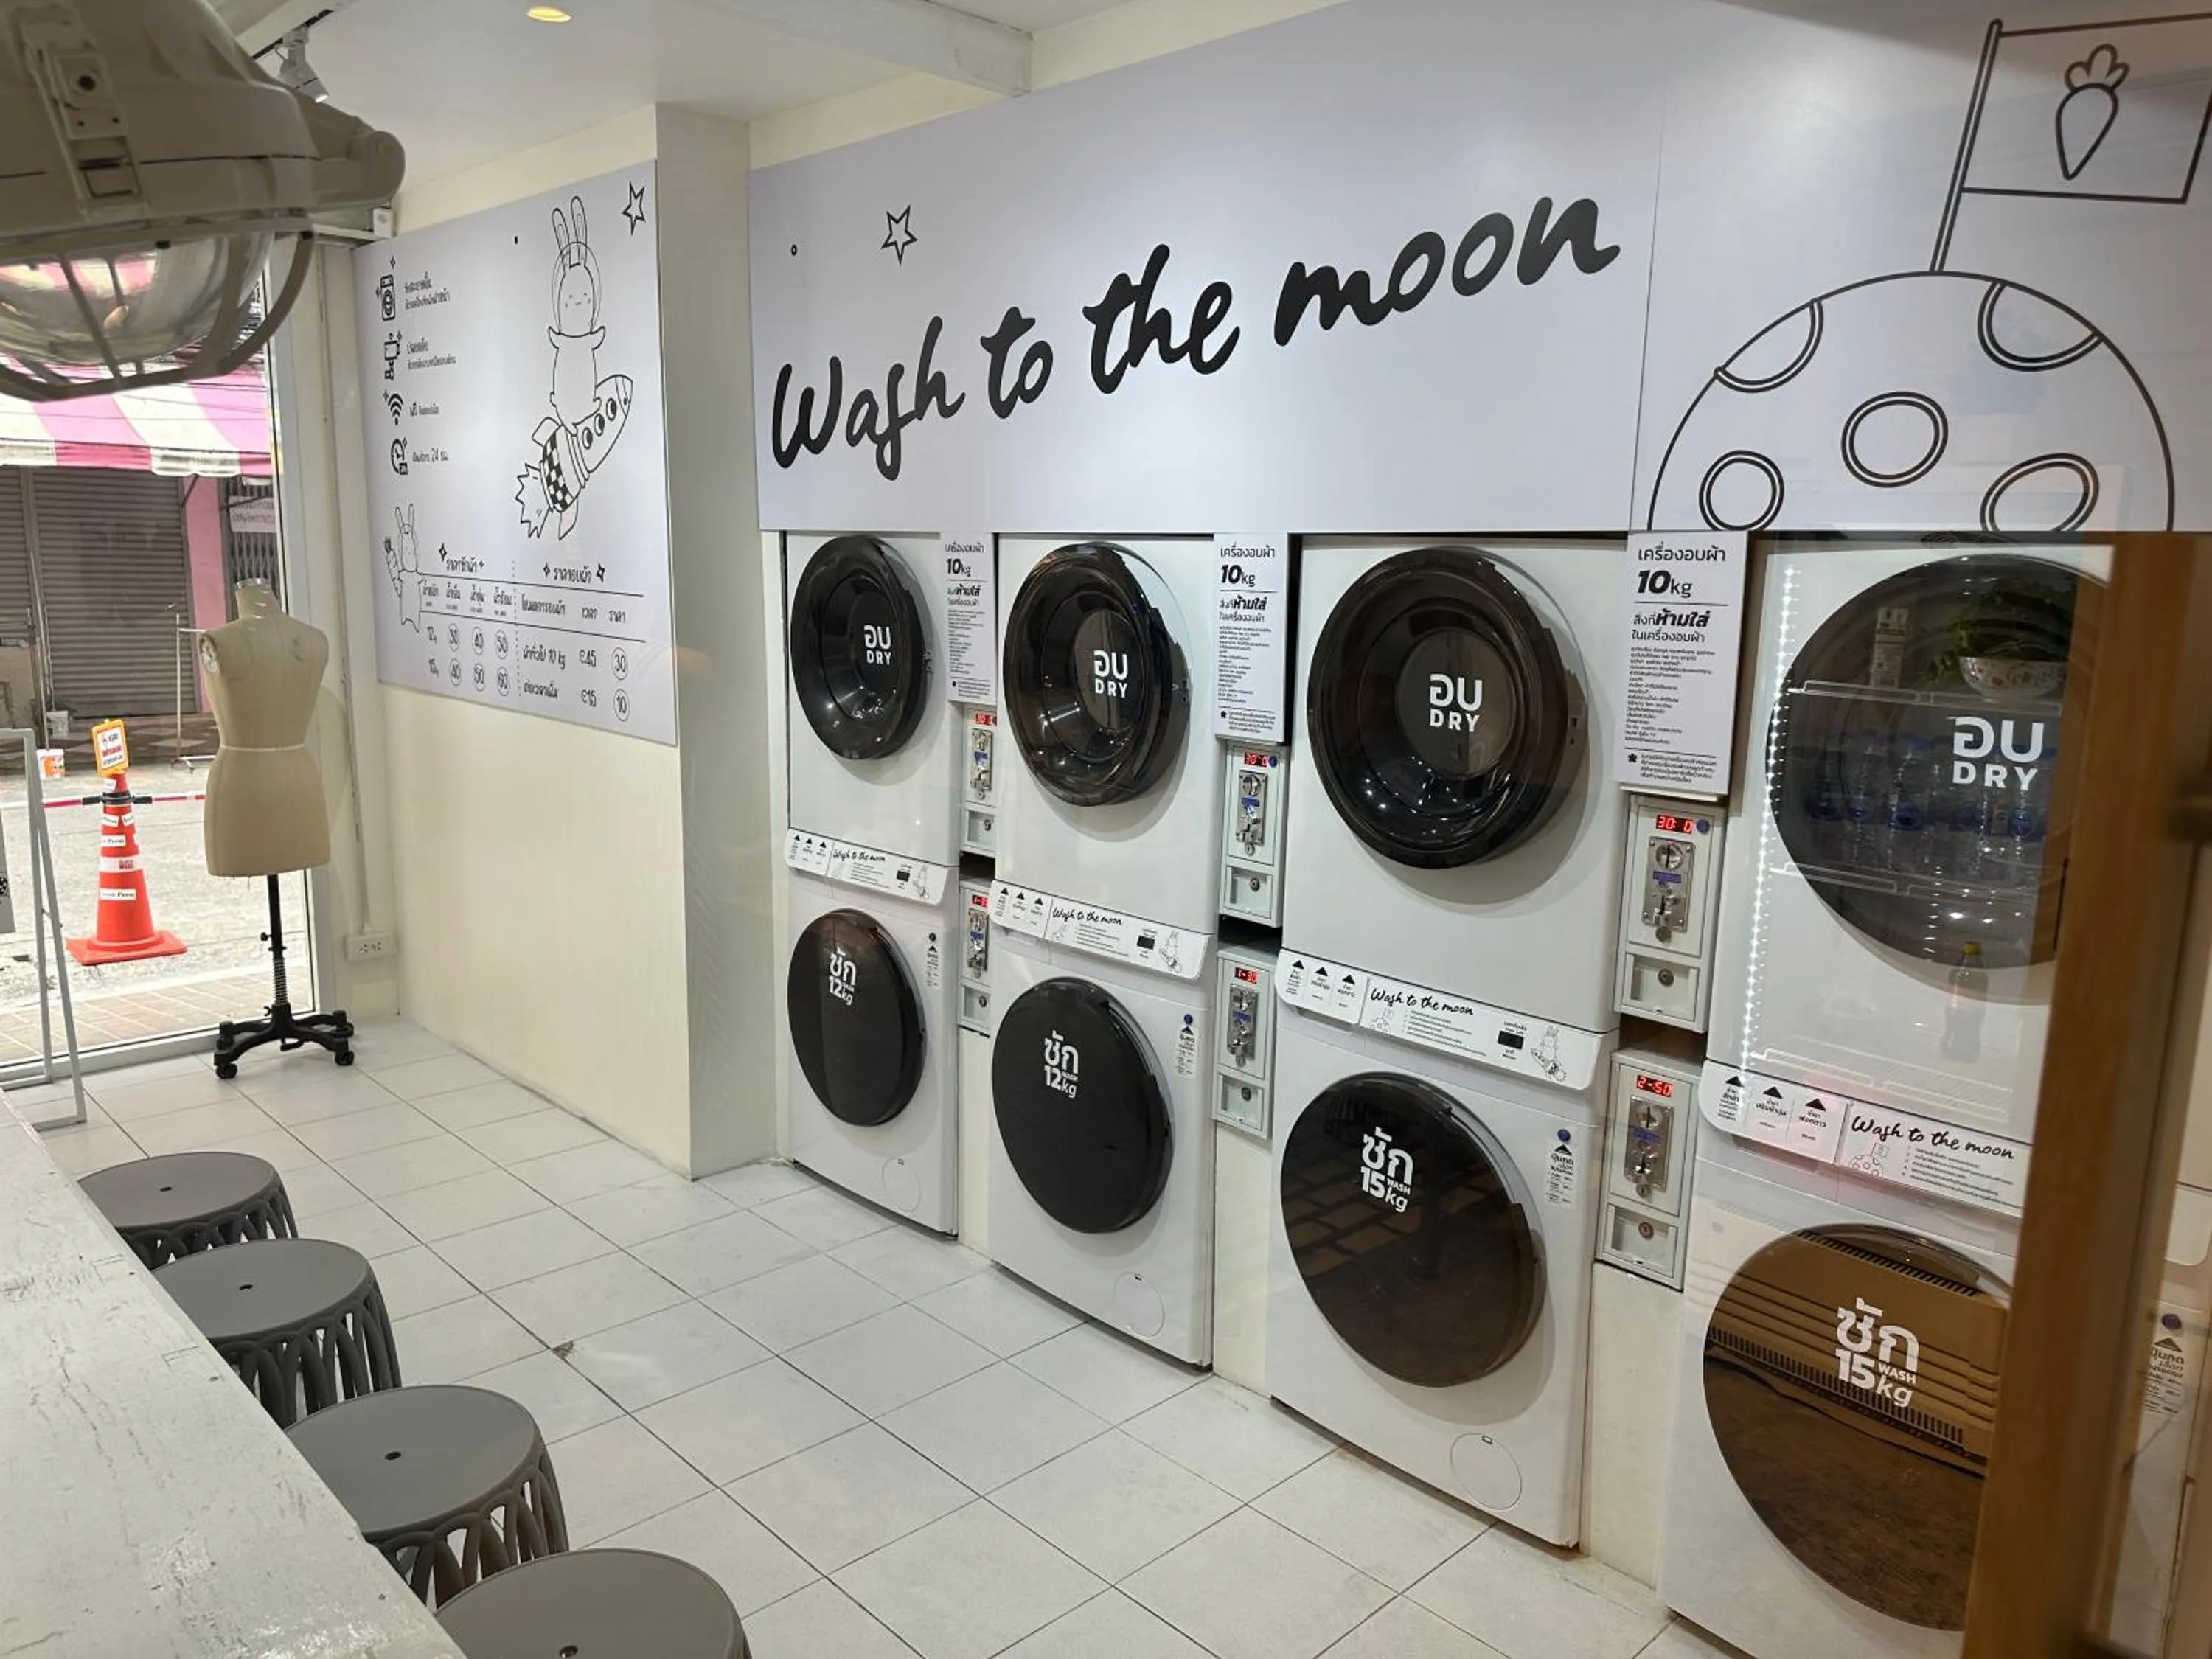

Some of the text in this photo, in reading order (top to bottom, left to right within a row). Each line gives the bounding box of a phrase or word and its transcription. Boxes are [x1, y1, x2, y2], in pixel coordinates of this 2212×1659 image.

[773, 195, 1621, 481] Wash to the moon
[1220, 541, 1275, 558] เครื่องอบผ้า
[1638, 540, 1726, 562] เครื่องอบผ้า
[554, 566, 591, 583] ราคาอบผ้า
[946, 558, 971, 577] 10kg
[1221, 564, 1256, 588] 10kg
[1638, 569, 1693, 598] 10kg
[609, 610, 626, 623] ราคา
[1633, 608, 1711, 627] สิ่งที่ห้ามใส่
[1632, 627, 1705, 643] ในเครื่องอบผ้า
[549, 650, 556, 664] 10
[614, 654, 626, 673] 30
[866, 651, 891, 665] DRY
[1095, 678, 1127, 698] DRY
[616, 695, 627, 714] 10
[1430, 708, 1481, 732] DRY
[1952, 760, 2038, 791] DRY
[1053, 907, 1121, 925] Wash to the moon
[830, 947, 857, 986] ซัก
[829, 975, 853, 1006] 12kg
[1371, 988, 1474, 1015] Wash to the moon
[1044, 1029, 1079, 1074] ซัก
[1044, 1065, 1077, 1099] 12kg
[1851, 1116, 2014, 1159] Wash to the moon
[1362, 1126, 1413, 1186] ซัก
[1360, 1166, 1408, 1213] 15kg
[1837, 1297, 1919, 1372] ซัก
[1835, 1348, 1913, 1408] 15kg
[1878, 1362, 1916, 1385] WASH
